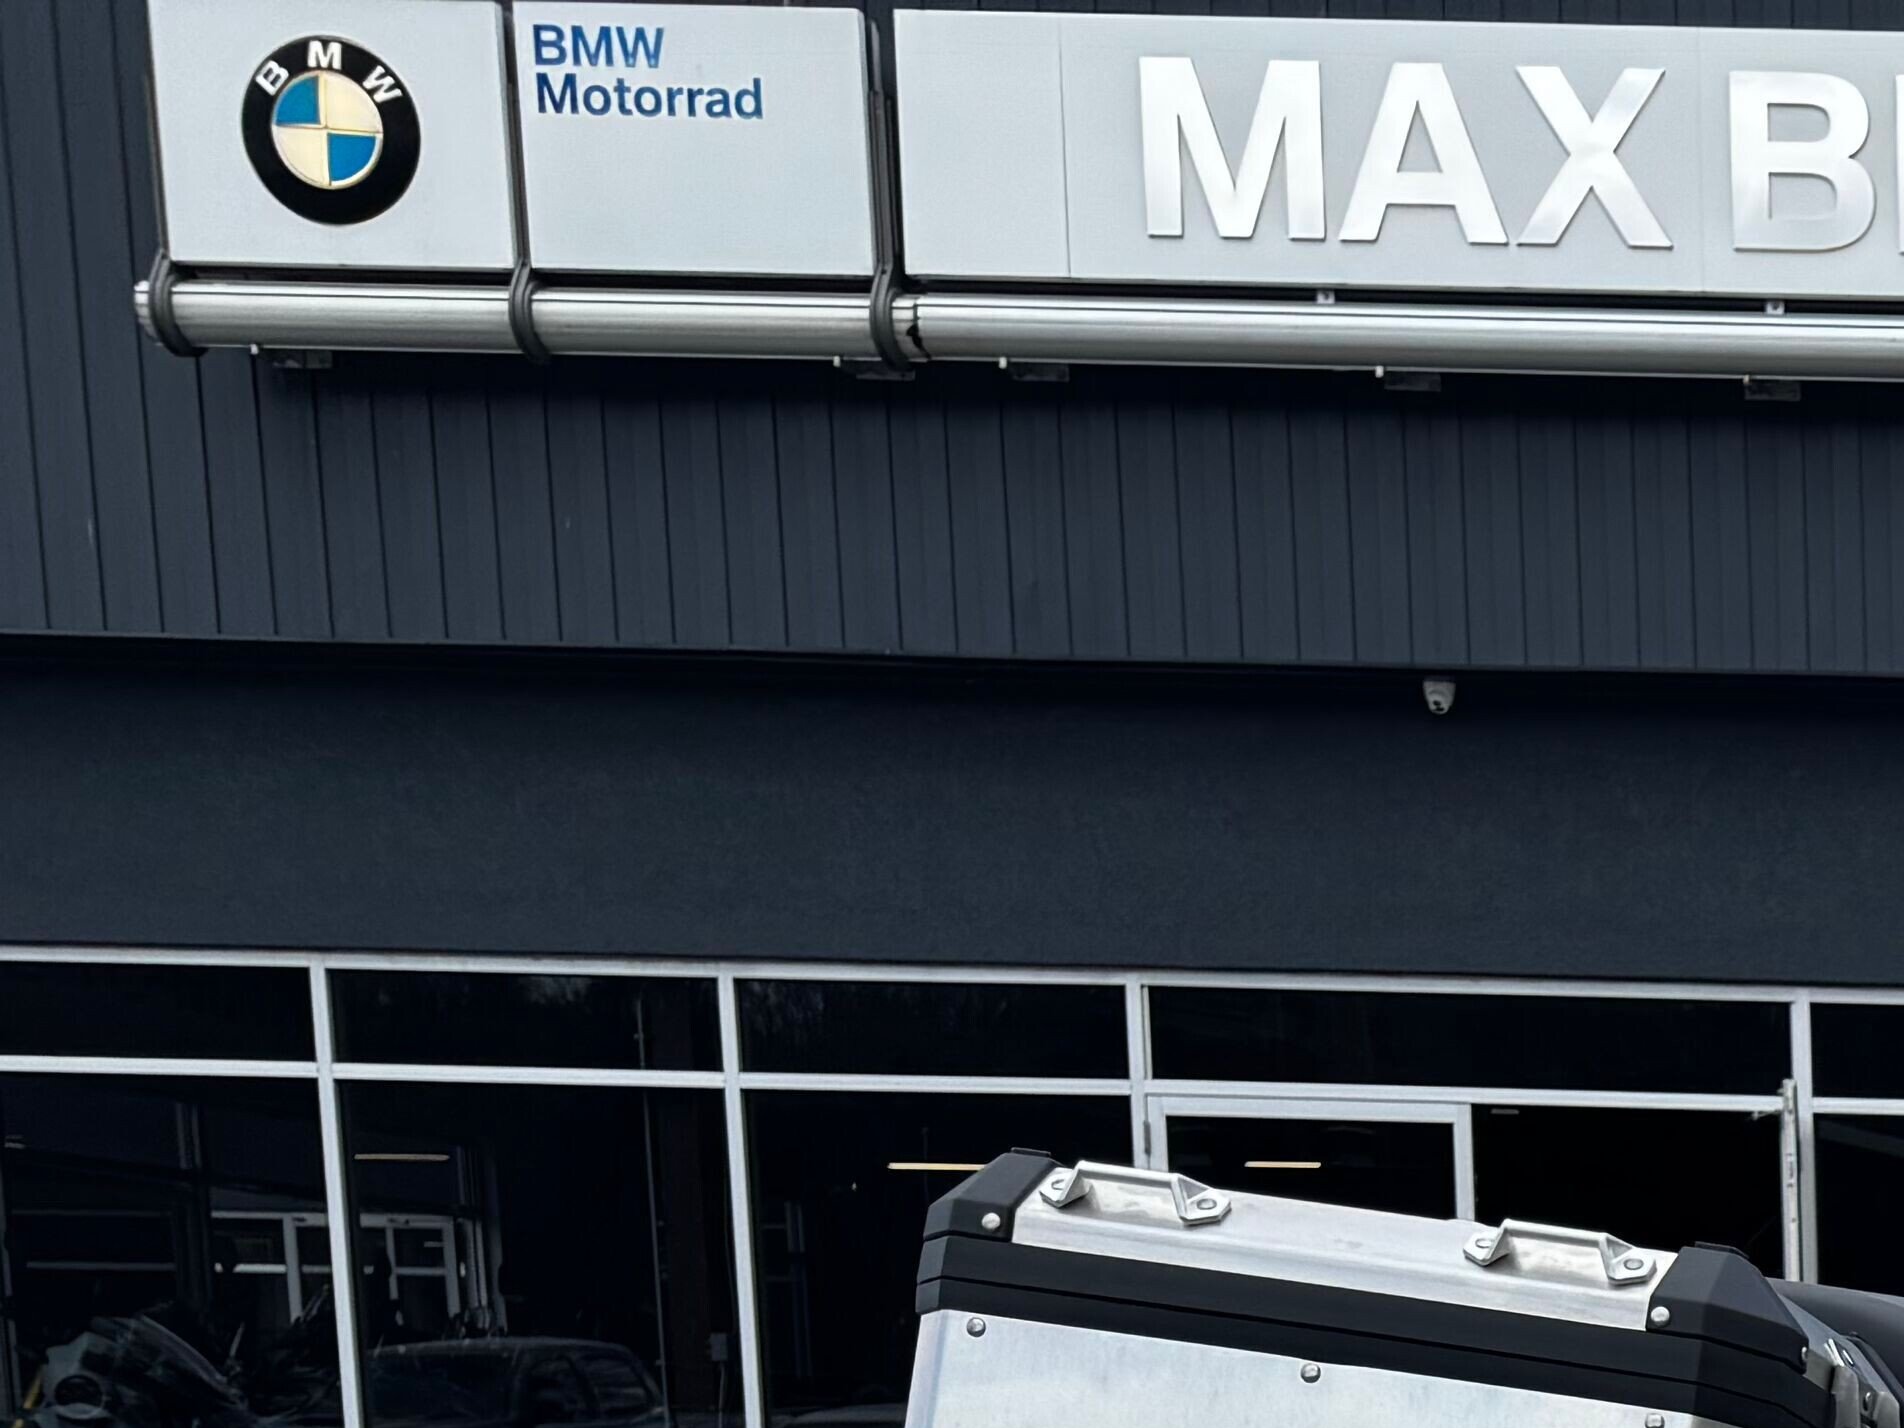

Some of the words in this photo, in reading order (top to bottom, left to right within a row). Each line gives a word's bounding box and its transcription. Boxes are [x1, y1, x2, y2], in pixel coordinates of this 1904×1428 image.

[255, 40, 402, 103] BMW
[533, 24, 664, 68] BMW
[536, 72, 763, 120] Motorrad
[1137, 55, 1674, 249] MAX
